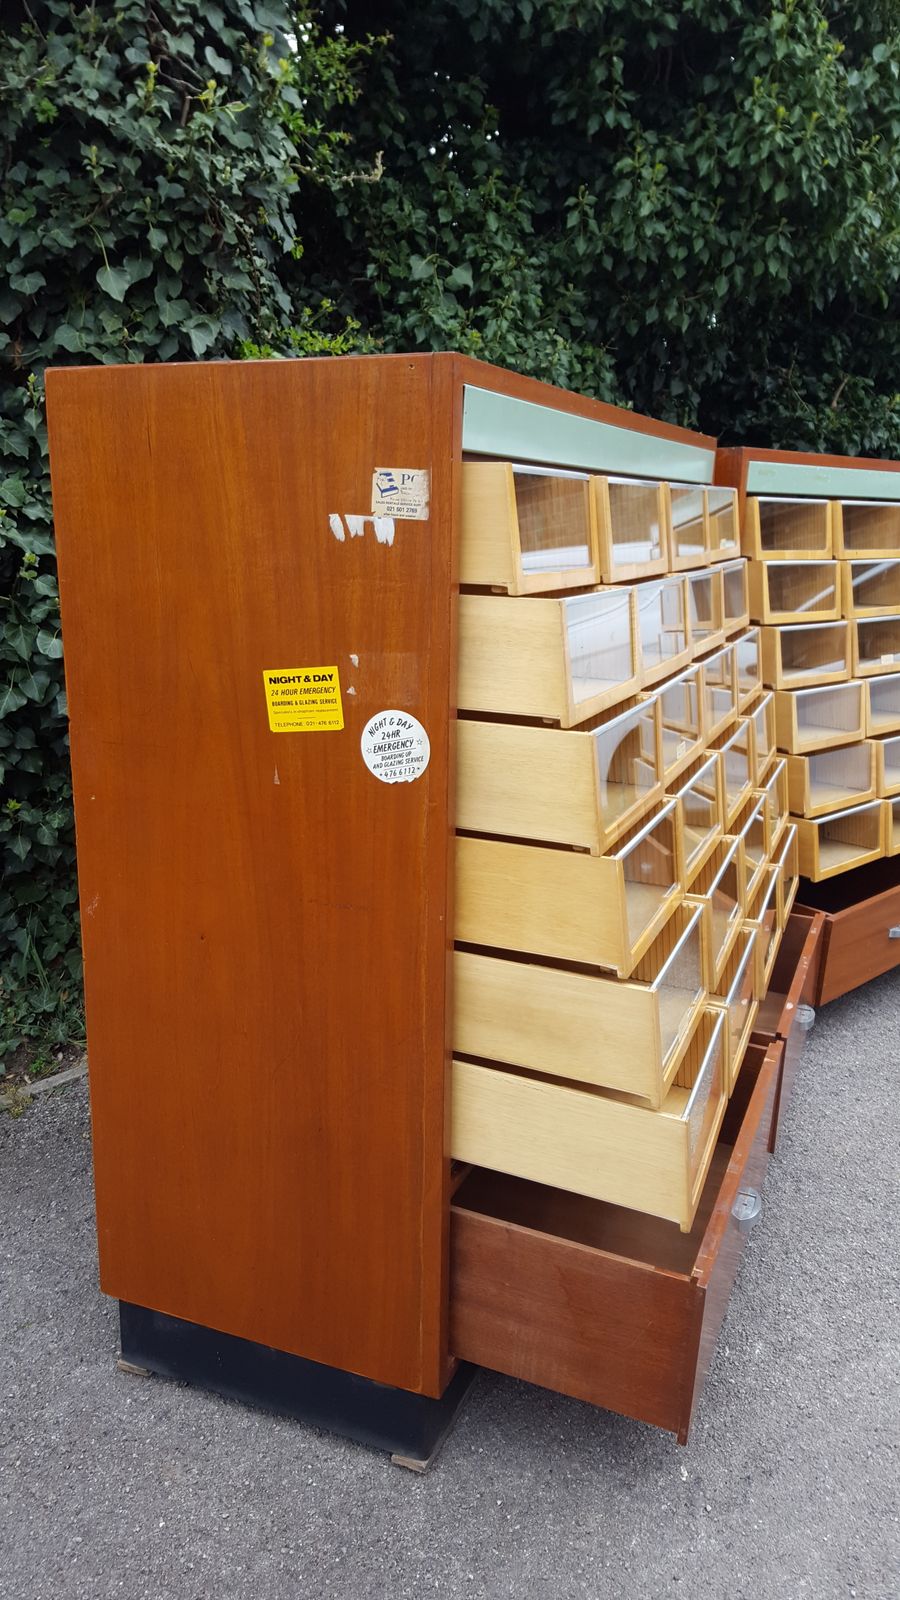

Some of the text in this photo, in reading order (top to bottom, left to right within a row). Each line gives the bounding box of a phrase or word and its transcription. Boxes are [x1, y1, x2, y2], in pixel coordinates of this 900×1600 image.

[269, 676, 302, 684] NIGHT
[313, 674, 334, 682] DAY
[300, 686, 336, 695] EMERGENCY
[368, 717, 414, 737] NIGHT & DAY
[381, 730, 401, 740] 24HR
[373, 739, 414, 753] EMERGENCY
[381, 753, 404, 761] BOARDING
[384, 759, 404, 767] GLAZING
[405, 756, 424, 764] SERVICE
[399, 767, 416, 775] 6112
